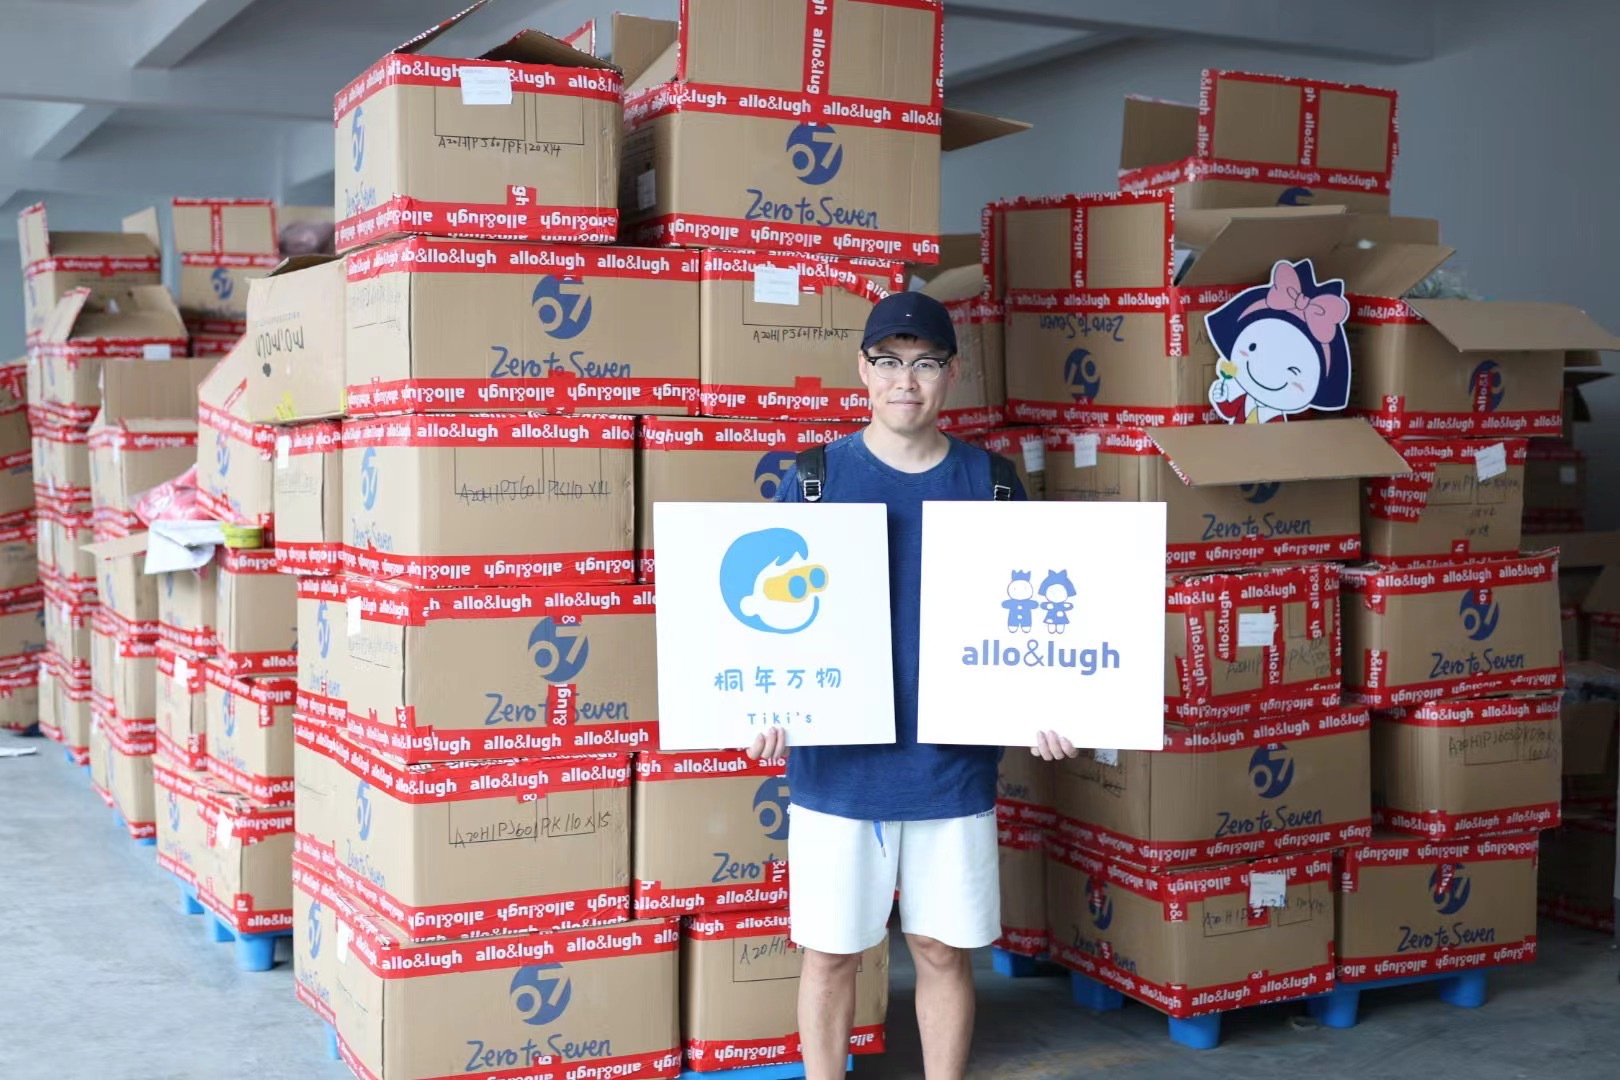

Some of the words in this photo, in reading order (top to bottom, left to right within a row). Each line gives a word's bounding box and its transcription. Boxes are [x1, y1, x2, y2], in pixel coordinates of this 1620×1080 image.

[507, 69, 556, 88] &lugh
[739, 94, 812, 113] allo&lugh
[822, 102, 892, 121] allo&lugh
[446, 209, 526, 230] allo&lugh
[745, 188, 793, 222] Zero
[797, 197, 816, 219] to
[816, 197, 879, 230] Seven
[668, 219, 739, 242] allo&lugh
[751, 228, 822, 248] allo&lugh
[833, 236, 902, 255] allo&lugh
[509, 250, 585, 271] allo&lugh
[597, 253, 670, 274] allo&lugh
[1118, 292, 1169, 309] allo&lugh
[490, 346, 542, 378] Zero
[569, 351, 632, 378] Seven
[478, 384, 555, 402] allo&lugh
[567, 383, 641, 402] allo&lugh
[758, 391, 829, 409] allo&lugh
[1116, 410, 1166, 427] allo&lugh
[417, 423, 499, 442] allo&lugh
[511, 423, 590, 442] allo&lugh
[715, 429, 786, 447] allo&lugh
[1201, 514, 1240, 542] Zero
[1263, 512, 1311, 538] Seven
[1206, 546, 1264, 562] allo&lugh
[1274, 542, 1331, 558] allo&lugh
[484, 560, 563, 579] allo&lugh
[1376, 572, 1435, 588] allo&lugh
[1443, 569, 1492, 584] allo&lugh
[1499, 563, 1545, 578] allo&lugh
[453, 594, 532, 612] allo&lugh
[545, 591, 621, 609] allo&lugh
[1241, 583, 1296, 600] allo&lugh
[962, 639, 1120, 676] allo&lugh
[1429, 652, 1466, 679] Zero
[1484, 648, 1525, 672] Seven
[714, 666, 842, 694] 桐年万物
[1260, 697, 1314, 711] allo&lugh
[1391, 687, 1444, 703] allo&lugh
[485, 692, 537, 726] Zero
[747, 711, 813, 725] Tiki's
[1414, 708, 1473, 722] allo&lugh
[1481, 704, 1530, 719] allo&lugh
[484, 734, 561, 753] allo&lugh
[574, 728, 648, 748] allo&lugh
[1185, 730, 1245, 747] allo&lugh
[1253, 720, 1310, 739] allo&lugh
[471, 771, 548, 791] allo&lugh
[1216, 812, 1254, 838] Zero
[1274, 805, 1322, 831] Seven
[1390, 814, 1446, 833] allo&lugh
[1455, 815, 1500, 831] allo&lugh
[1507, 808, 1550, 825] allo&lugh
[1207, 840, 1265, 856] allo&lugh
[1275, 831, 1331, 848] allo&lugh
[1355, 846, 1409, 861] allo&lugh
[1418, 842, 1469, 859] allo&lugh
[712, 853, 760, 883] Zero
[1168, 875, 1232, 893] allo&lugh
[497, 899, 575, 919] allo&lugh
[635, 894, 705, 912] allo&lugh
[716, 889, 788, 906] allo&lugh
[1397, 926, 1433, 952] Zero
[1450, 922, 1495, 947] Seven
[382, 950, 462, 970] allo&lugh
[475, 941, 554, 963] allo&lugh
[566, 931, 642, 952] allo&lugh
[1375, 957, 1427, 975] allo&lugh
[1435, 950, 1487, 967] allo&lugh
[1192, 985, 1250, 1007] allo&lugh
[1259, 972, 1318, 994] allo&lugh
[465, 1040, 518, 1072] Zero
[547, 1033, 612, 1060] Seven
[714, 1043, 787, 1062] allo&lugh
